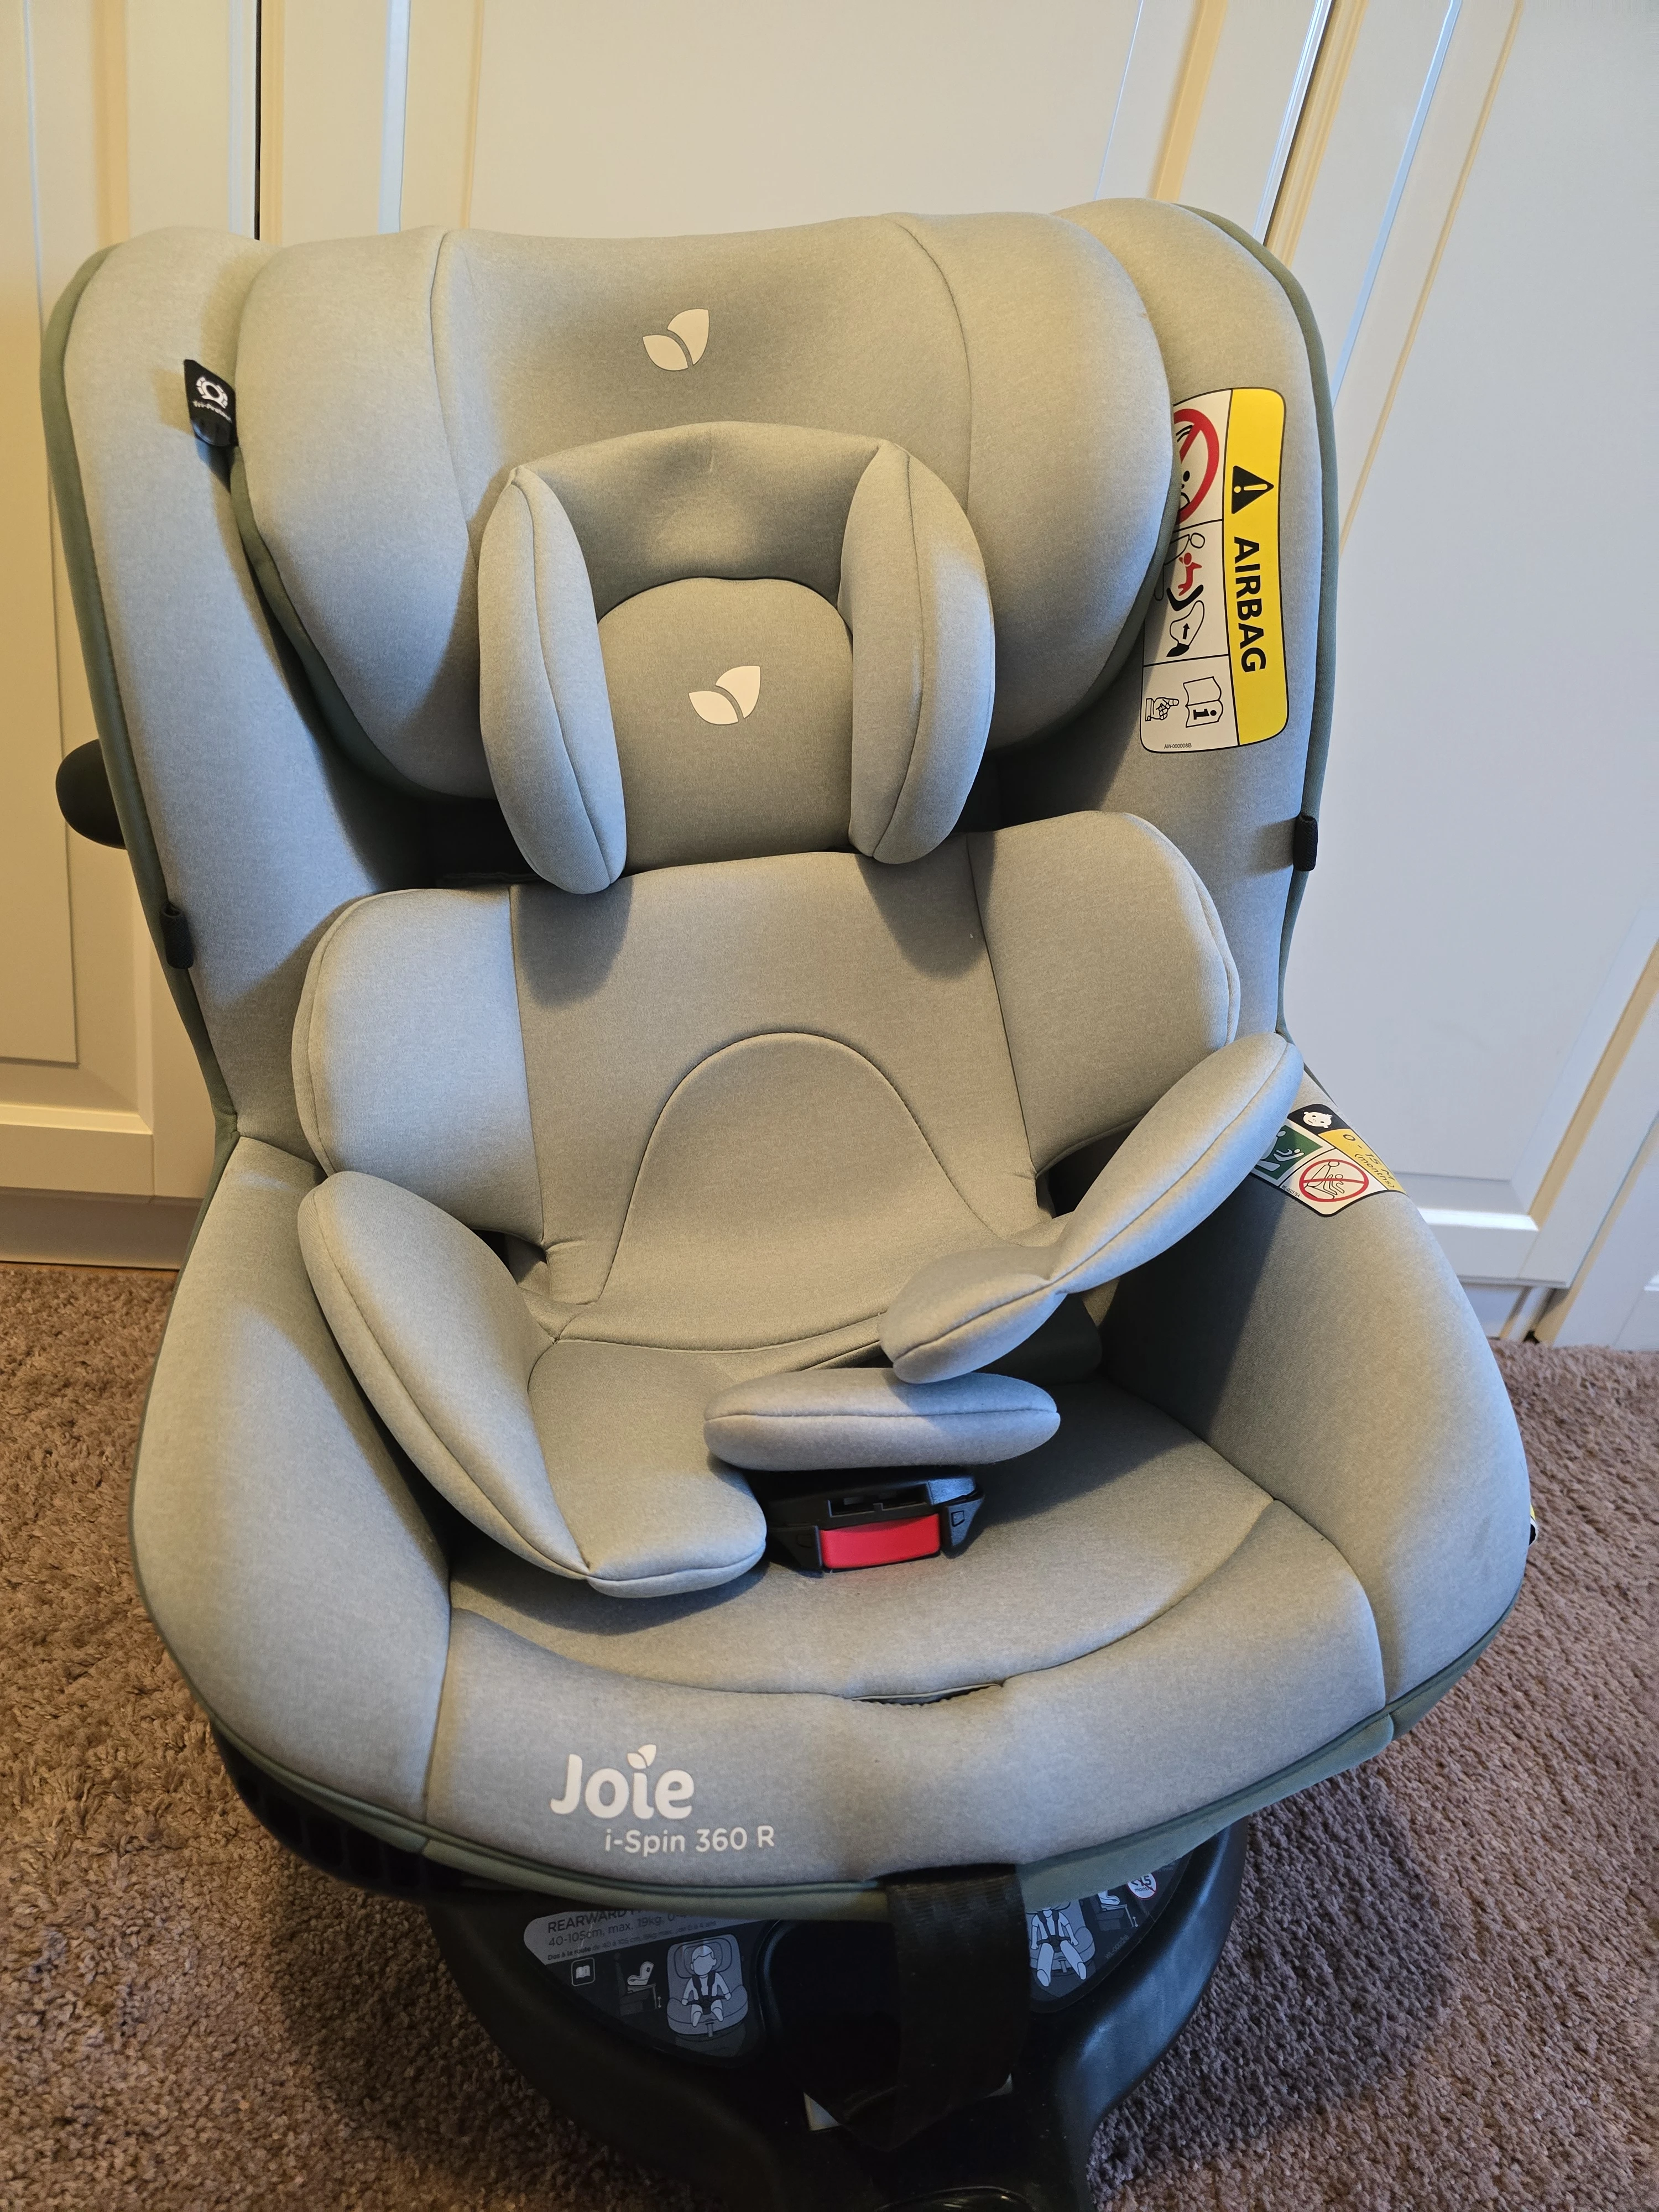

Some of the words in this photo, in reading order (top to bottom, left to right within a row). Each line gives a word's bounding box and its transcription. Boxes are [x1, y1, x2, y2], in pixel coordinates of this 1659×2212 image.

[1234, 536, 1266, 672] AIRBAG
[1354, 1153, 1395, 1188] (months)
[1365, 1153, 1383, 1166] 15
[1381, 1168, 1395, 1181] M
[550, 1745, 695, 1819] Joie
[604, 1828, 686, 1858] i-Spin
[695, 1827, 748, 1852] 360
[757, 1825, 775, 1848] R
[547, 1911, 628, 1934] REARWARD
[608, 1922, 634, 1934] max.
